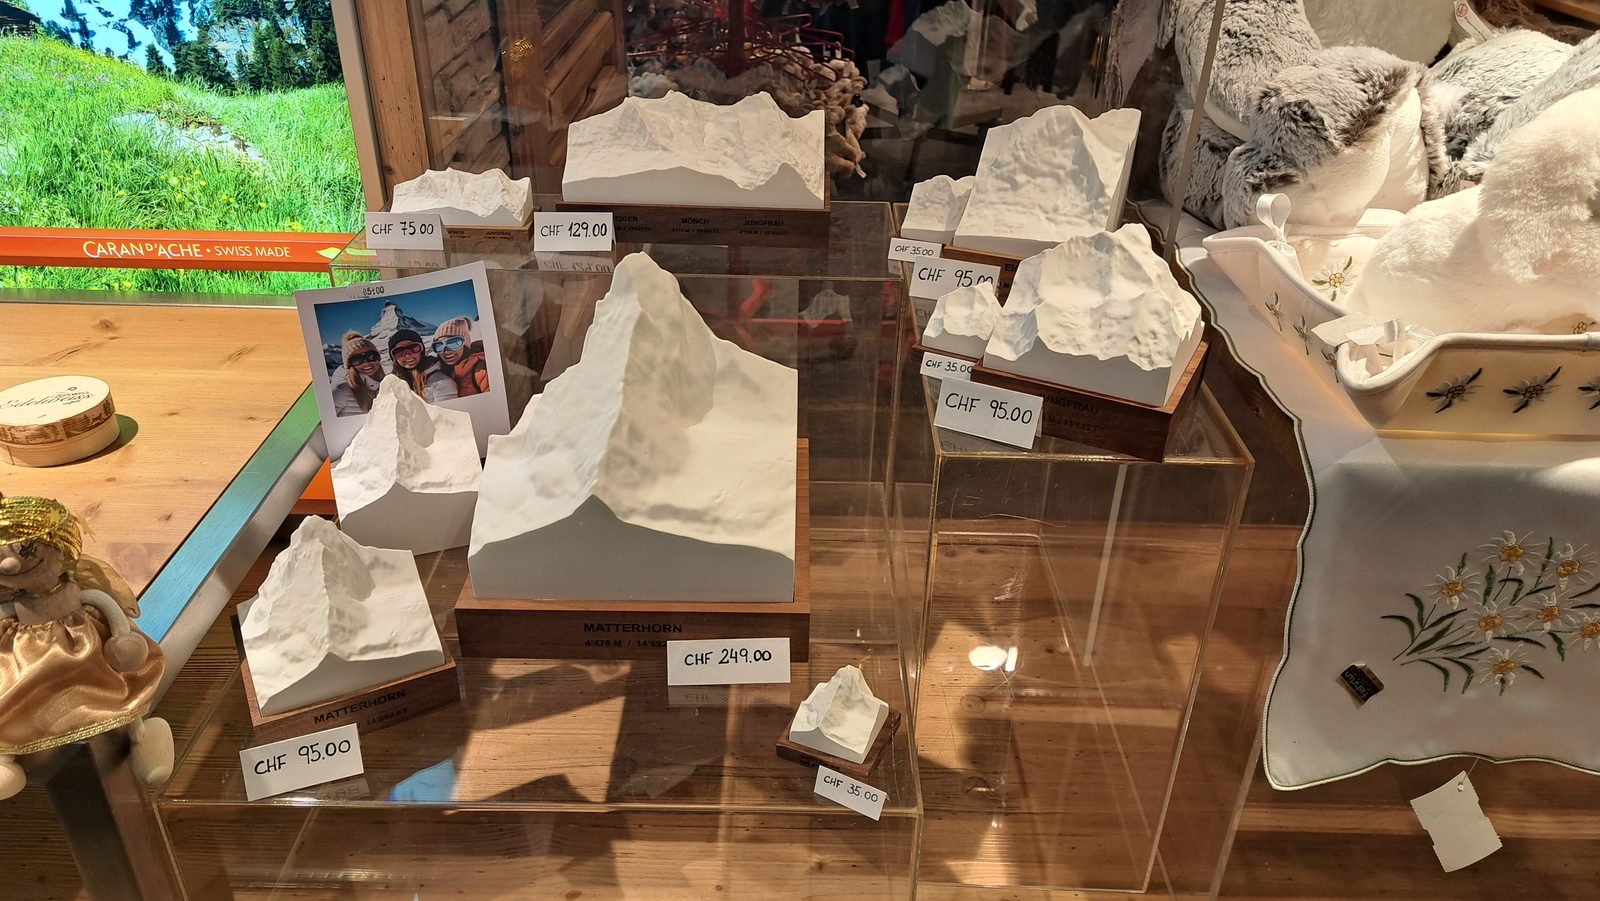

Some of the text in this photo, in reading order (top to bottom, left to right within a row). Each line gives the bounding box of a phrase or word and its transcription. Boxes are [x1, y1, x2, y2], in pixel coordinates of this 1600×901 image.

[371, 221, 434, 236] CHF 75.00
[540, 224, 564, 237] CHF
[568, 221, 608, 238] 129.00
[83, 240, 144, 258] CARAN
[215, 245, 252, 257] SWISS
[255, 246, 291, 258] MADE
[894, 245, 910, 253] CHF
[918, 267, 946, 282] CHF
[925, 359, 943, 369] CHF
[945, 393, 1033, 425] CHF 95.00
[583, 622, 683, 634] MATTERHORN
[614, 639, 622, 648] M
[684, 648, 772, 666] CHF 249.00
[313, 689, 406, 724] MATTERHORN
[254, 739, 351, 775] CHF 95.00
[823, 775, 879, 803] CHF 35.00
